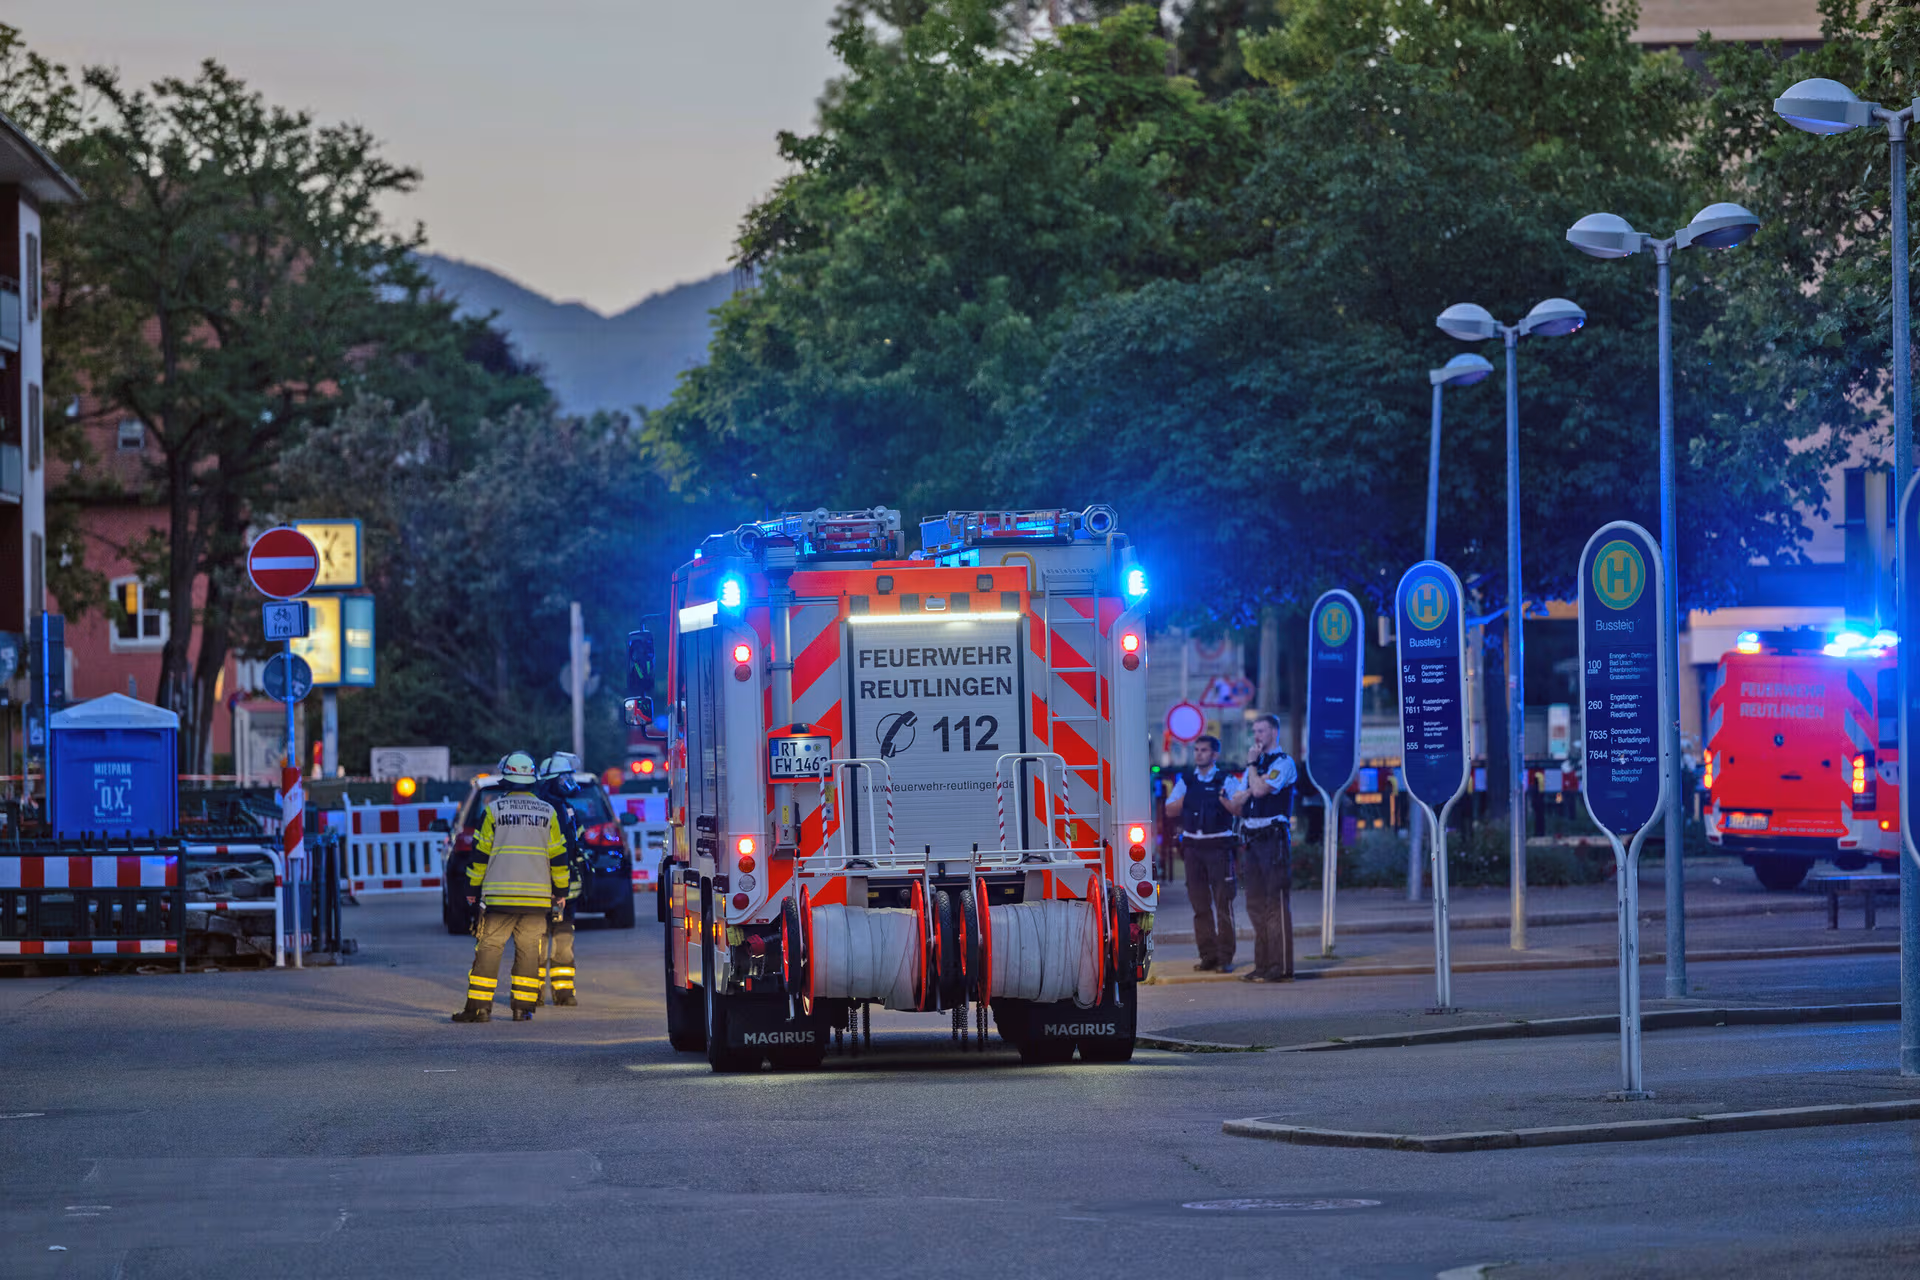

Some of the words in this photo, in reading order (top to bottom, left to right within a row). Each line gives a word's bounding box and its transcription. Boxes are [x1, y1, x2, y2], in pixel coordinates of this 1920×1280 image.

[1606, 557, 1631, 593] H
[1417, 588, 1437, 617] H
[273, 623, 293, 635] frei
[1595, 619, 1635, 633] Bussteig
[1409, 637, 1441, 648] Bussteig
[859, 646, 1012, 668] FEUERWEHR
[1403, 665, 1411, 673] 5/
[1587, 660, 1602, 669] 100
[1404, 675, 1416, 683] 155
[860, 677, 1012, 699] REUTLINGEN
[1740, 682, 1825, 698] FEUERWEHR
[1610, 693, 1639, 701] Engstingen
[1405, 706, 1420, 714] 7611
[1587, 700, 1603, 710] 260
[1740, 702, 1824, 718] REUTLINGEN
[933, 715, 999, 752] 112
[1406, 725, 1415, 733] 12
[1588, 730, 1608, 740] 7635
[1610, 727, 1642, 735] Sonnenbühl
[781, 742, 798, 756] RT
[1406, 742, 1419, 750] 555
[1588, 750, 1608, 760] 7644
[775, 758, 792, 772] FW
[1044, 1023, 1116, 1036] MAGIRUS
[744, 1031, 816, 1045] MAGIRUS
